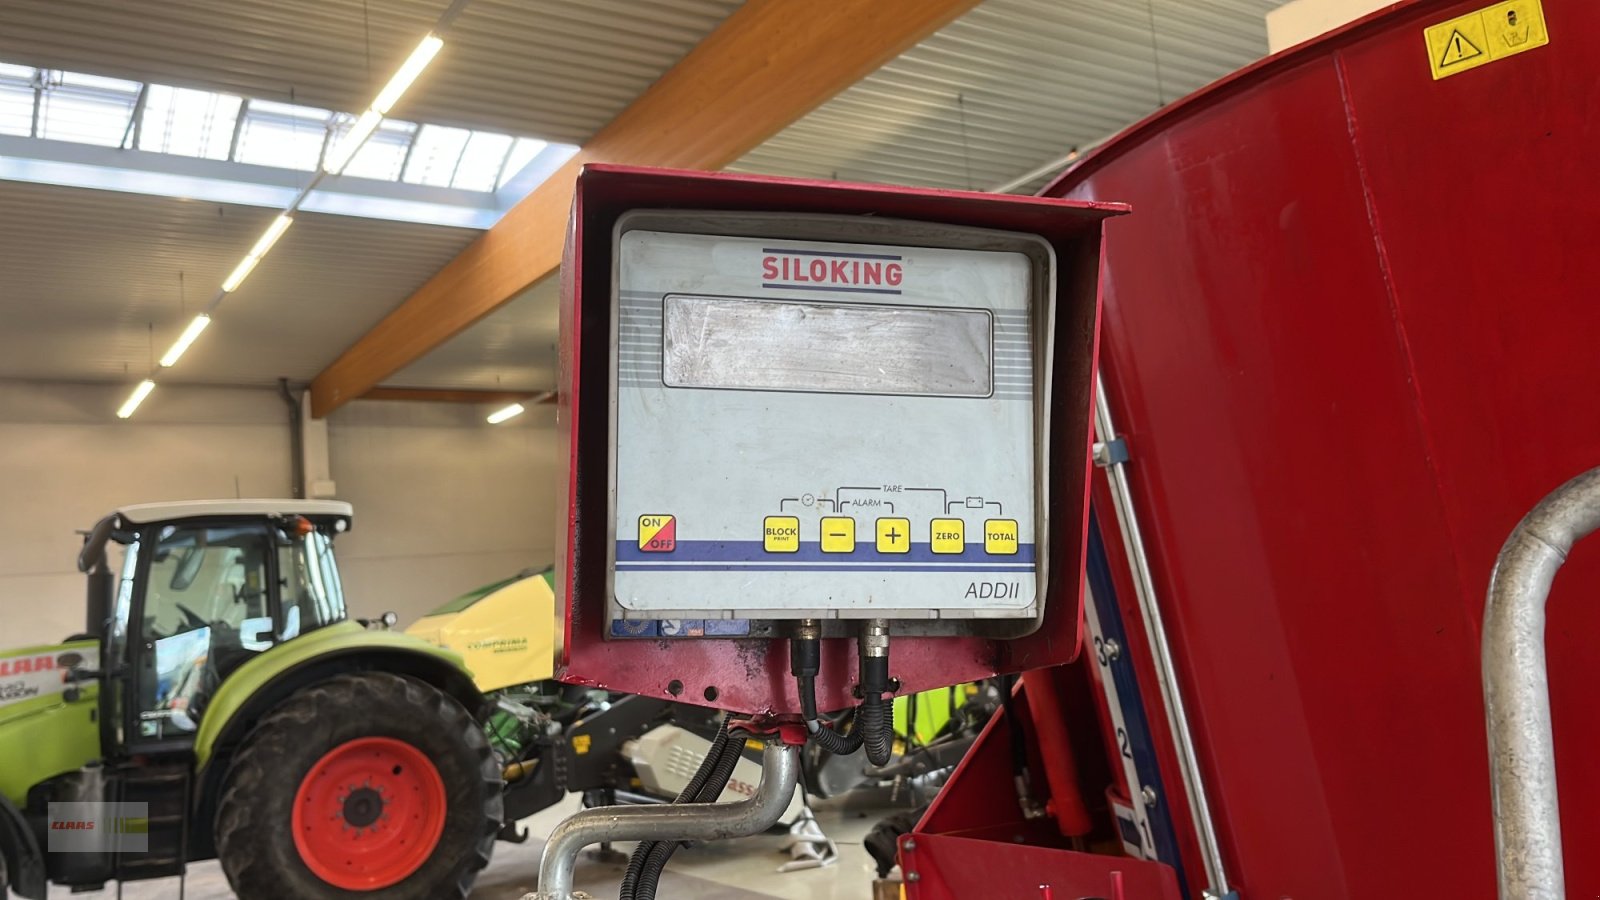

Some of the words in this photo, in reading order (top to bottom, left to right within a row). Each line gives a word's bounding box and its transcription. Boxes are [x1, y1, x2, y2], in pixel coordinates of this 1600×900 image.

[762, 256, 903, 286] SILOKING
[882, 485, 903, 493] TARE
[852, 499, 881, 507] ALARM
[642, 518, 661, 527] ON
[766, 527, 797, 536] BLOCK
[935, 532, 960, 540] ZERO
[987, 533, 1015, 541] TOTAL
[650, 539, 673, 549] OFF
[1094, 635, 1108, 667] 3
[0, 656, 60, 677] LAA
[1117, 727, 1133, 759] 2
[1140, 819, 1153, 849] 1
